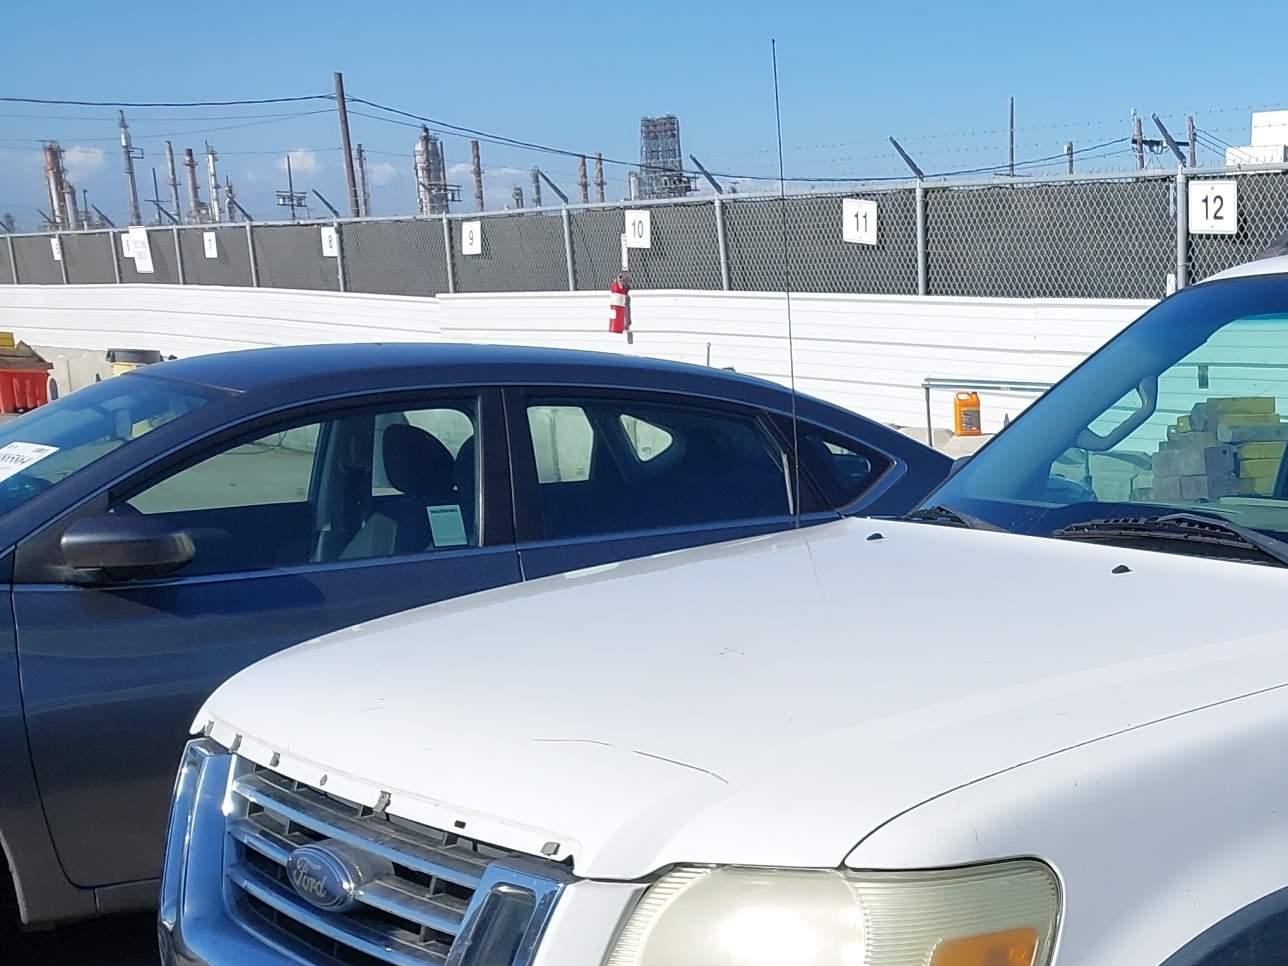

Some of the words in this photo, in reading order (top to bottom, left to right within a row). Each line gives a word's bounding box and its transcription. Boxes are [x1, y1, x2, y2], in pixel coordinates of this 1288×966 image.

[1201, 194, 1224, 221] 12
[631, 219, 644, 239] 10
[853, 211, 868, 233] 11
[327, 234, 334, 249] 8
[467, 230, 474, 246] 9
[293, 856, 328, 898] Ford
